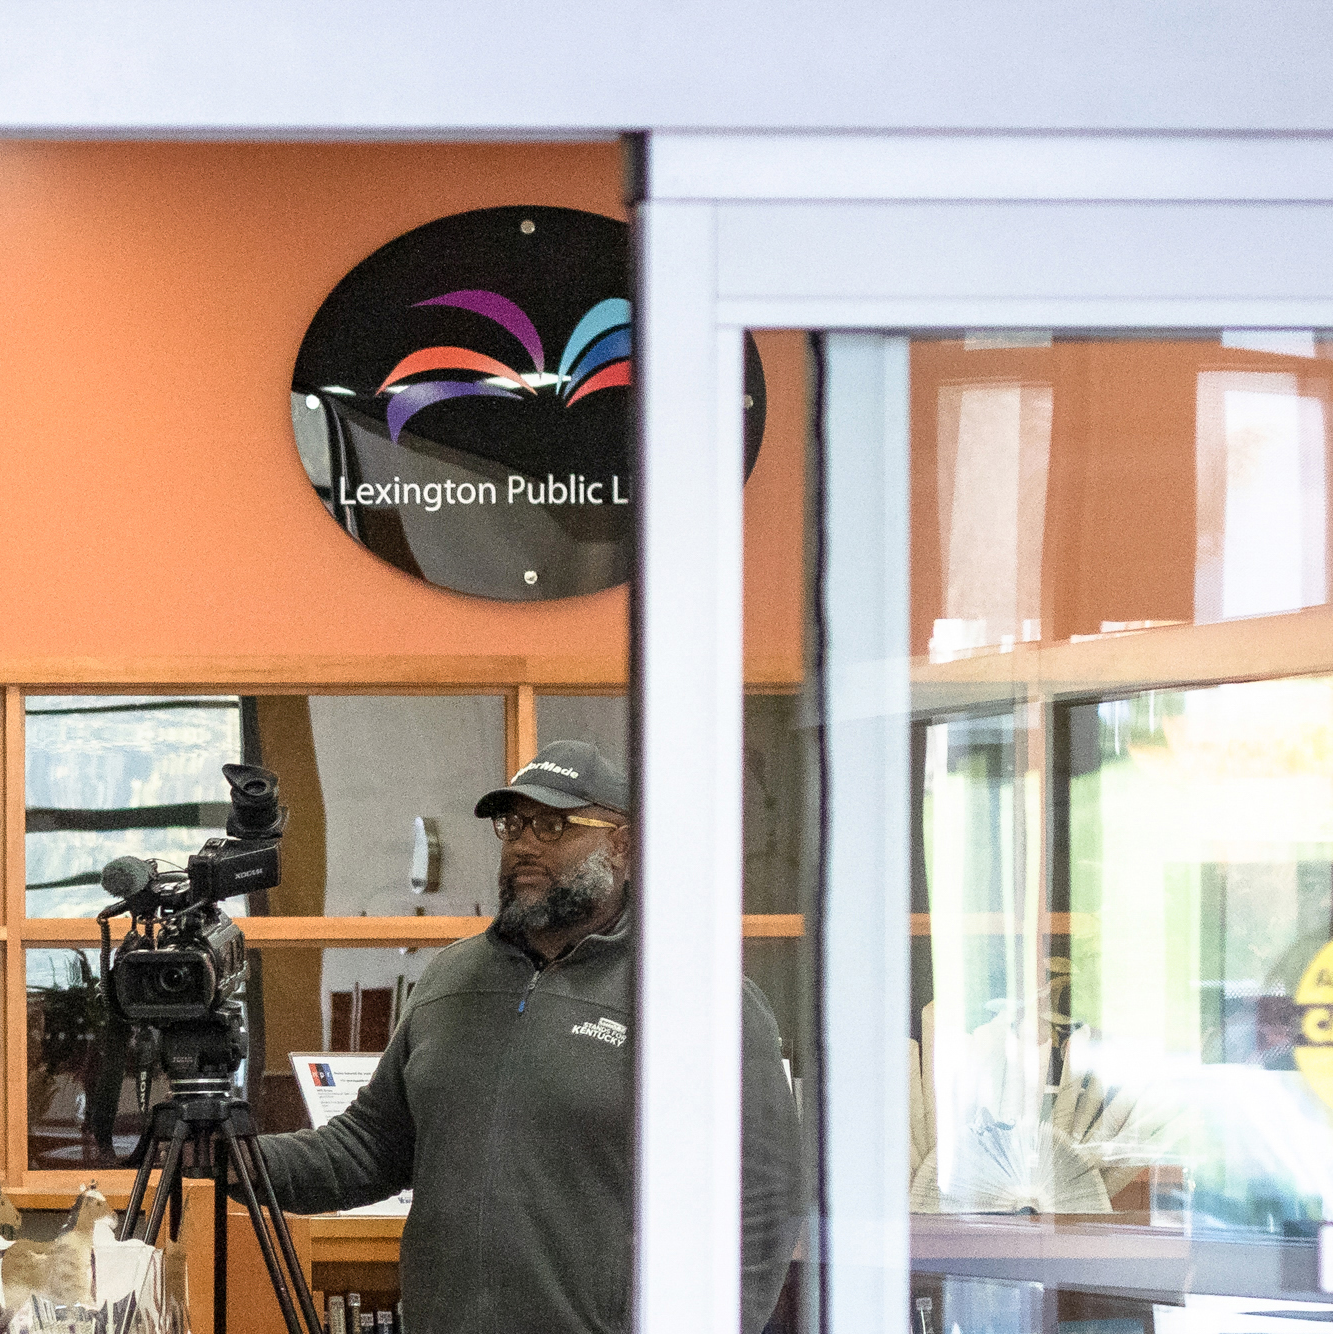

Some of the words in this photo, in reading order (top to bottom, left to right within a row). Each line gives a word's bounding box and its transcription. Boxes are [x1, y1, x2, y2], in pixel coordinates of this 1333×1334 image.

[339, 475, 497, 511] Lexington
[507, 474, 603, 504] Public
[572, 1024, 624, 1047] KENTUCKY
